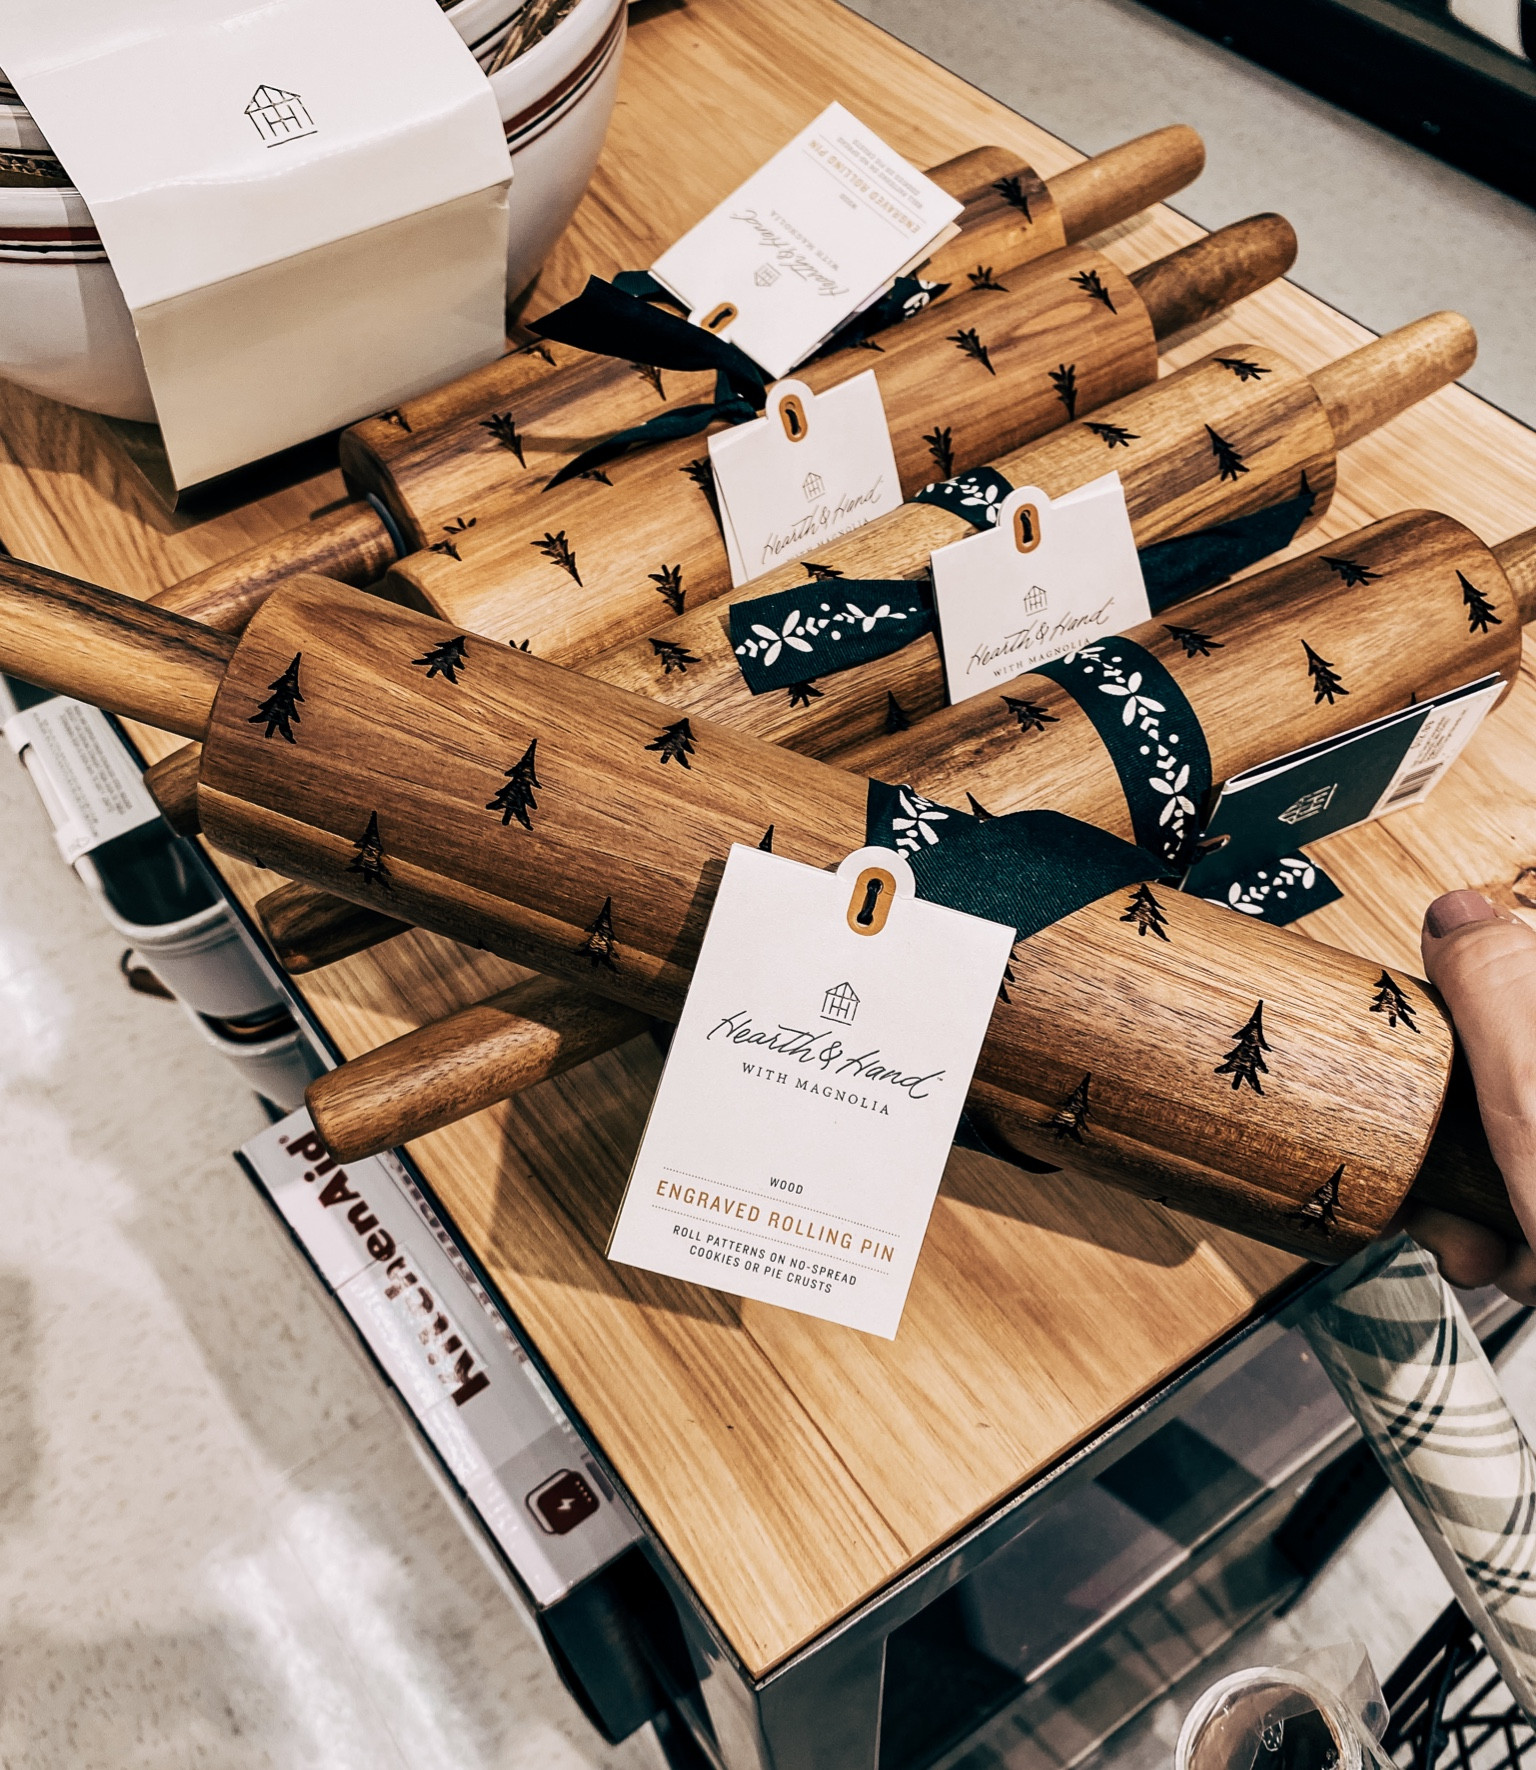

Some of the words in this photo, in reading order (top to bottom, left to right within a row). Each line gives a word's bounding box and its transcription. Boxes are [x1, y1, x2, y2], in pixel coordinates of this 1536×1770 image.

[809, 140, 828, 157] PIN
[828, 155, 870, 193] ROLLING
[730, 209, 790, 248] Hand
[869, 191, 921, 234] ENGRAVED
[776, 248, 798, 260] &
[779, 255, 850, 297] Hearth
[762, 505, 819, 564] Hearth
[819, 506, 831, 530] &
[832, 475, 883, 524] Hand
[966, 620, 1038, 675] Hearth
[1036, 622, 1050, 645] &
[1050, 597, 1114, 642] Hand
[993, 660, 1025, 678] WITH
[1028, 637, 1092, 664] MAGNOLIA
[706, 1010, 829, 1064] Hearth
[818, 1041, 844, 1070] &
[836, 1050, 946, 1099] Hand
[742, 1062, 788, 1085] WITH
[795, 1077, 891, 1116] MAGNOLIA
[769, 1176, 804, 1195] WOOD
[656, 1180, 761, 1223] ENGRAVED
[768, 1211, 853, 1250] ROLLING
[861, 1238, 896, 1263] PIN
[673, 1225, 702, 1242] ROLL
[706, 1234, 767, 1260] PATTERNS
[770, 1252, 786, 1265] ON
[790, 1256, 858, 1286] NO-SPREAD
[689, 1245, 741, 1269] COOKIES
[744, 1260, 761, 1274] OR
[764, 1265, 783, 1280] PIE
[787, 1272, 833, 1295] CRUSTS
